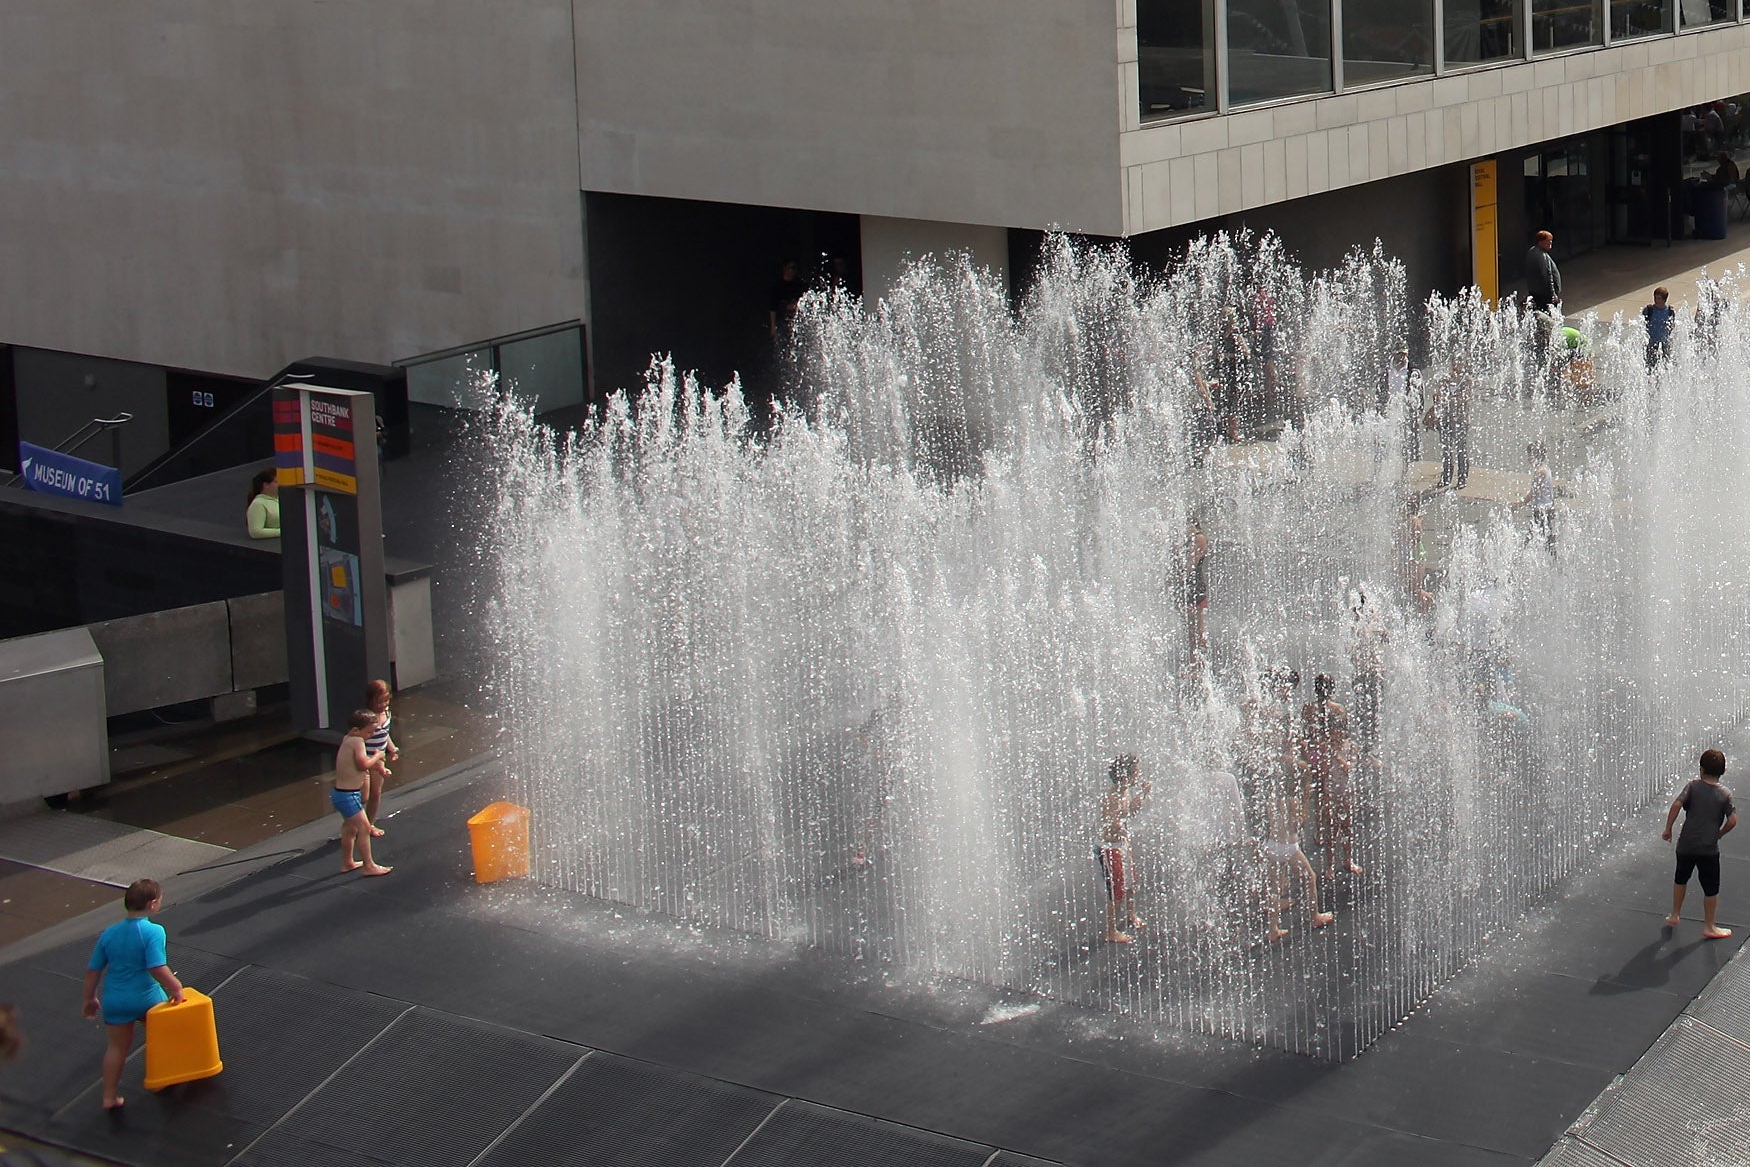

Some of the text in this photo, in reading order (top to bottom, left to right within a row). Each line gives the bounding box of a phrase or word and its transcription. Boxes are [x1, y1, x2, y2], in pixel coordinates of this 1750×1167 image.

[310, 399, 350, 419] SOUTHBANK
[311, 411, 337, 427] CENTRE
[78, 477, 94, 497] OF
[94, 482, 110, 501] 51
